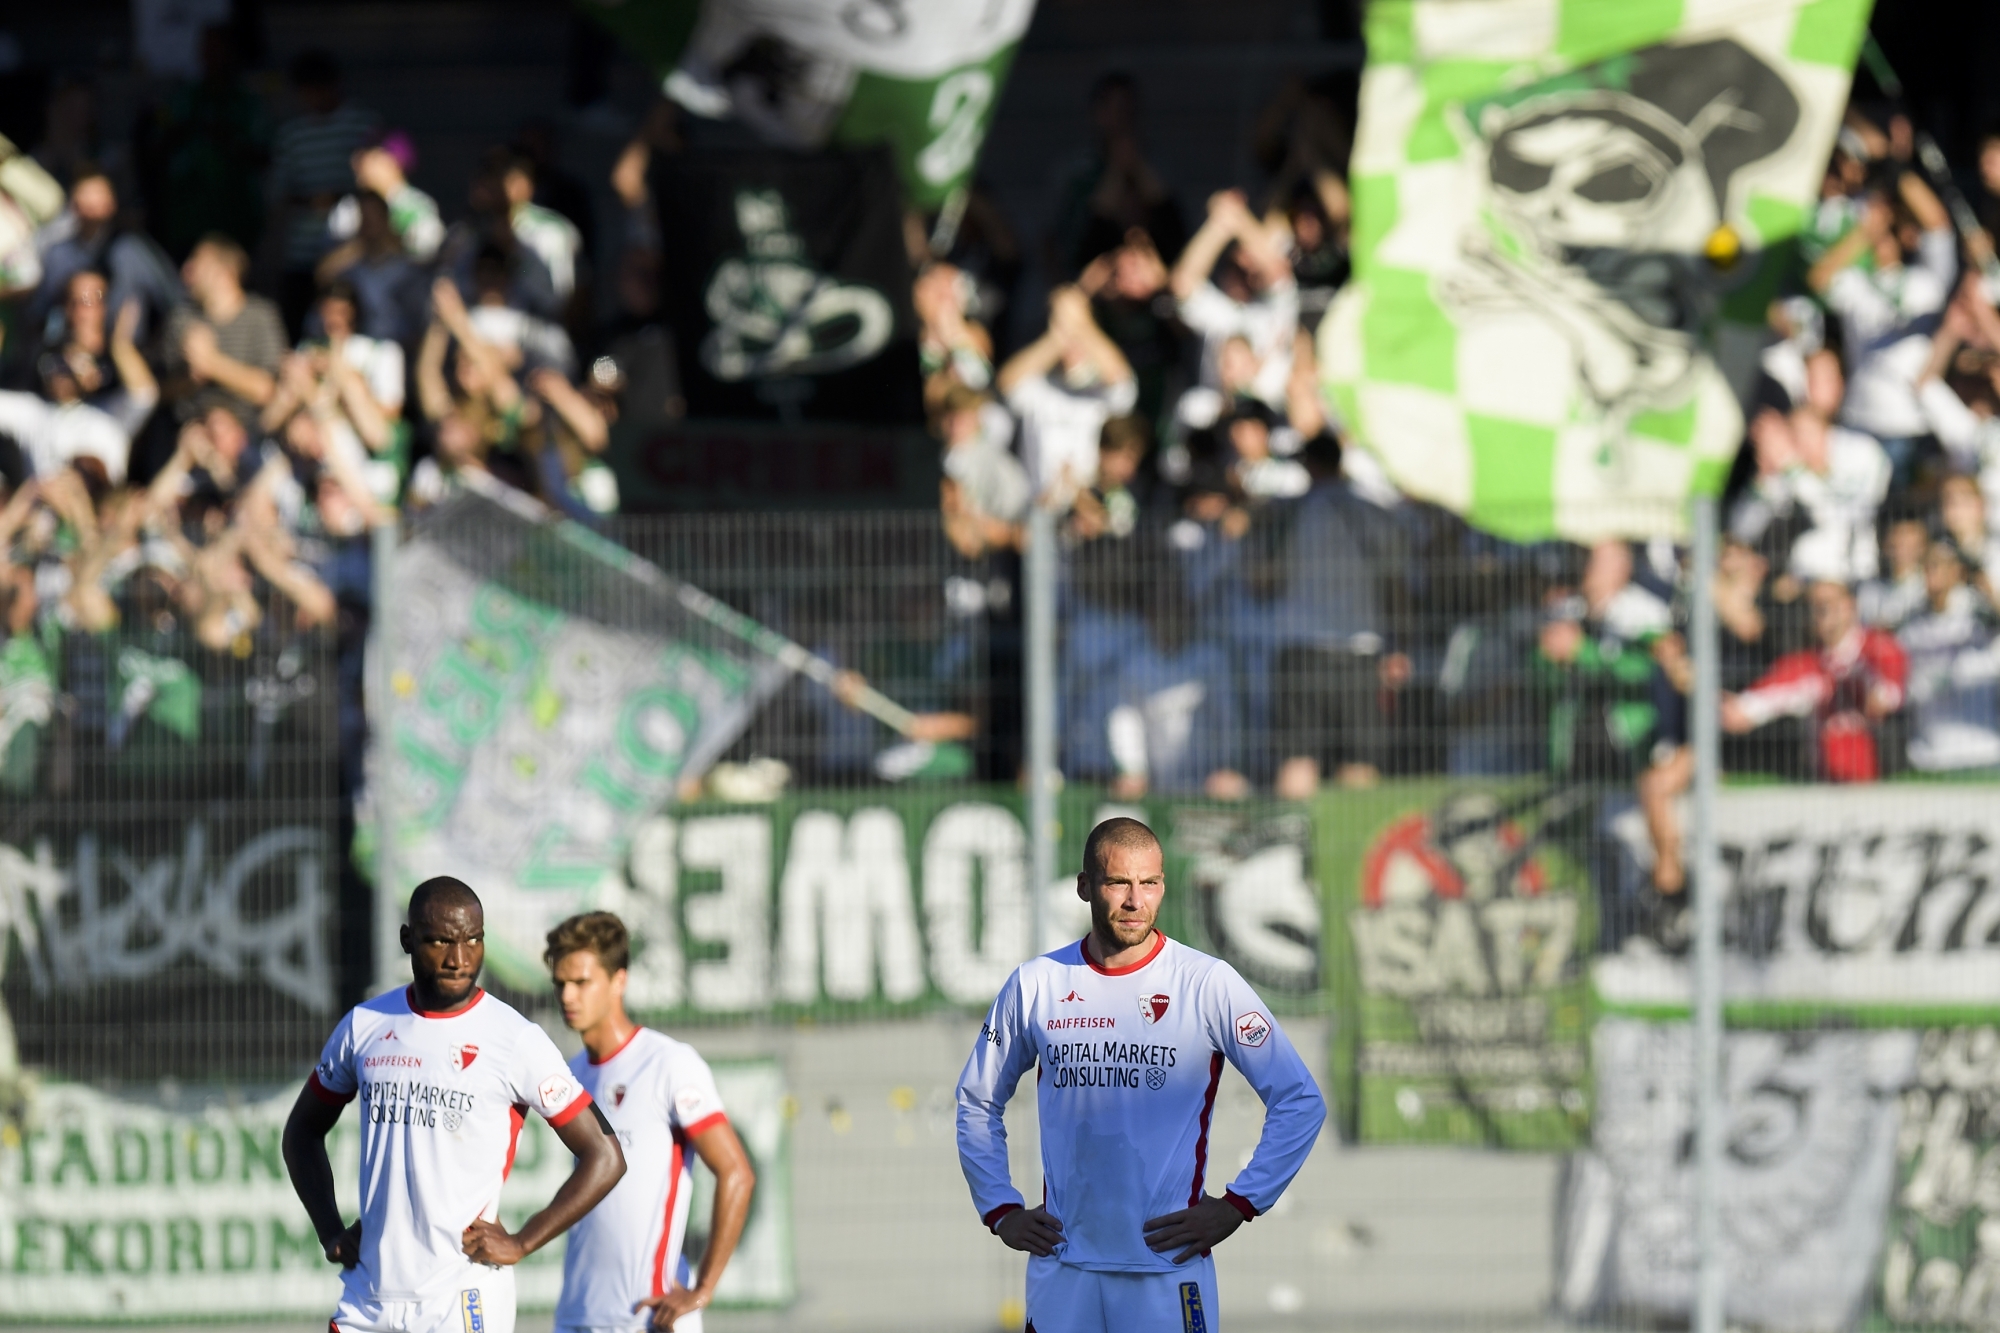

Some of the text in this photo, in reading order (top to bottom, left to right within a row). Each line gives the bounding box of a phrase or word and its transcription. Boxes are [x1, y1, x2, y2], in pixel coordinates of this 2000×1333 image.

[626, 803, 1055, 1013] OWER
[980, 1022, 1002, 1047] ndia
[1046, 1017, 1116, 1031] RAIFFEISEN
[363, 1055, 422, 1068] RAIFFEISEN
[1046, 1041, 1177, 1068] CAPITAL MARKETS
[1053, 1066, 1139, 1089] CONSULTING
[361, 1080, 475, 1113] CAPITAL MARKETS
[15, 1126, 288, 1184] TADION
[13, 1217, 328, 1273] EKORDM
[466, 1291, 481, 1333] arte
